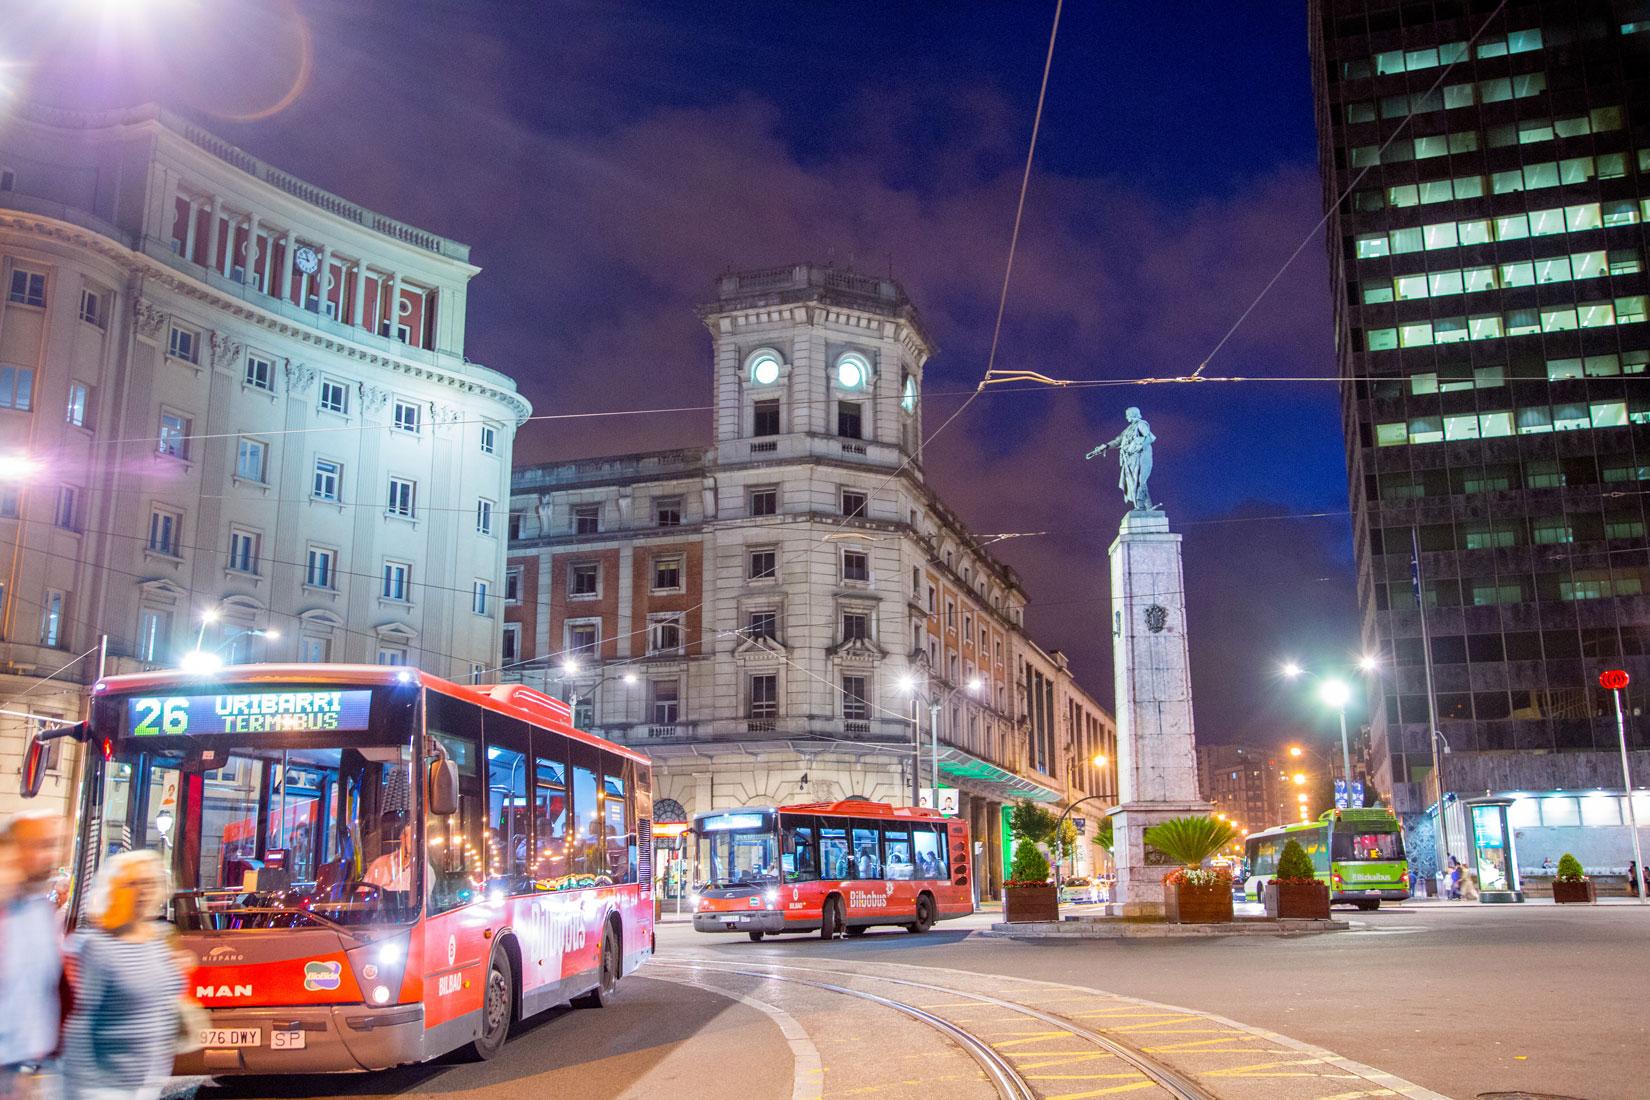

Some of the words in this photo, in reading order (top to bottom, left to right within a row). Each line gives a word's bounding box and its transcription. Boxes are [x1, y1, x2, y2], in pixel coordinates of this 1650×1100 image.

[215, 691, 342, 715] URIBARRI
[134, 697, 190, 736] 26
[221, 713, 338, 733] TERMIBUS
[850, 890, 887, 908] Bilbobus
[196, 984, 253, 998] MAN
[438, 972, 462, 996] BILBAO
[230, 1030, 257, 1044] DWY
